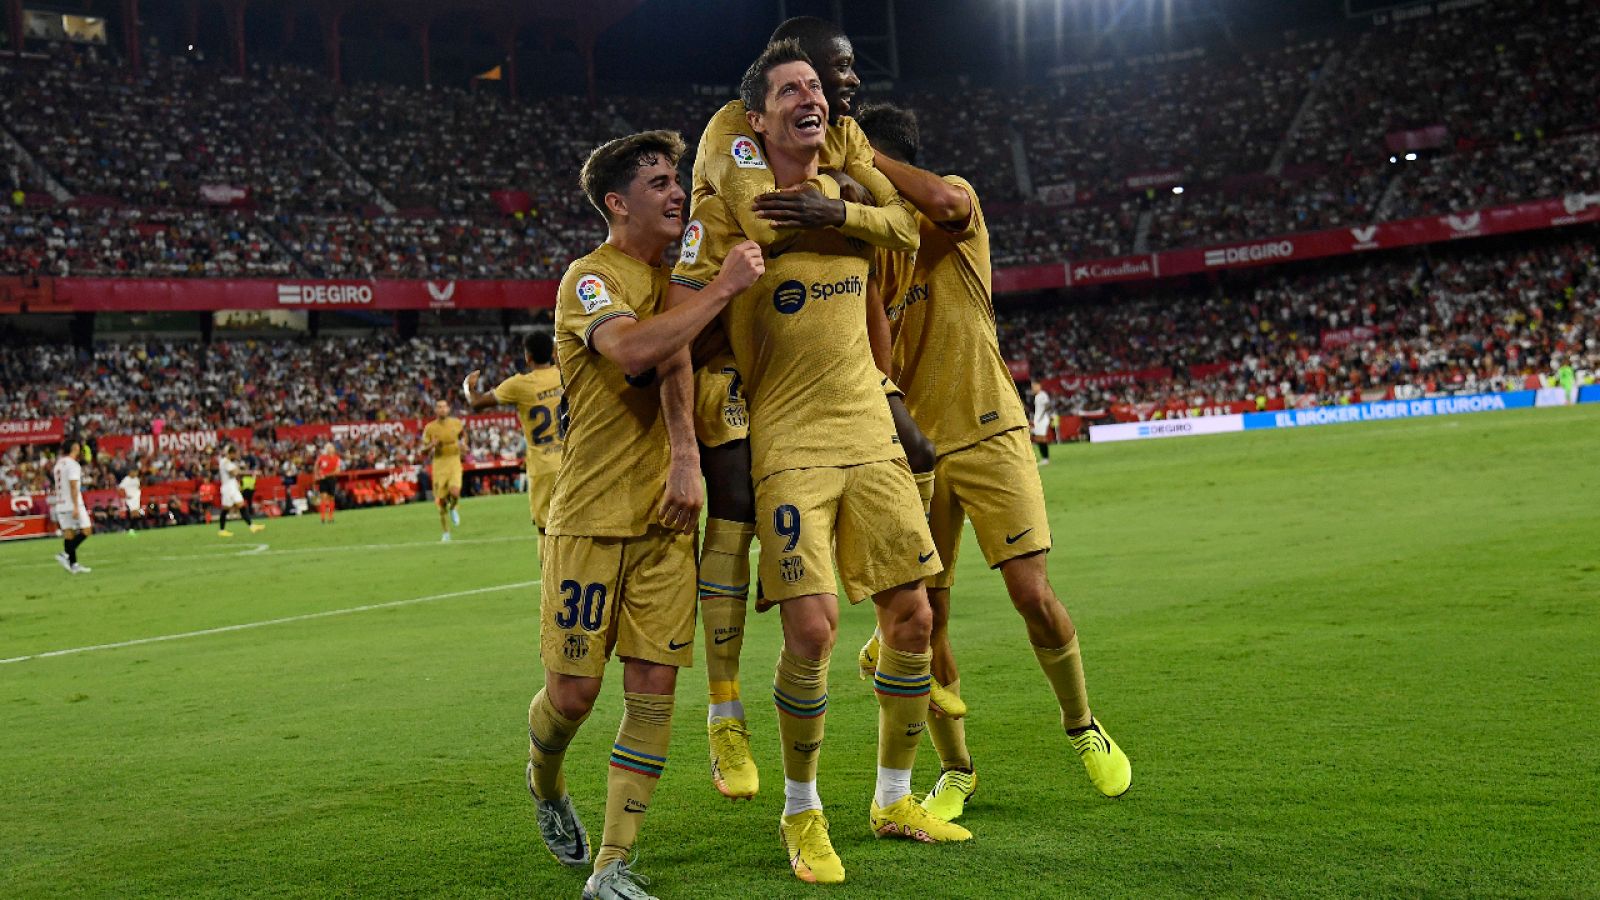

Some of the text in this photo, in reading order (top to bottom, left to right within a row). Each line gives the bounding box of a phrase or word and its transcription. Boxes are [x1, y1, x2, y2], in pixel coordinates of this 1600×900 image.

[1226, 241, 1294, 264] DEGIRO
[303, 285, 373, 304] DEGIRO
[810, 275, 864, 301] Spotify
[721, 366, 743, 402] 7
[1275, 413, 1297, 427] EL
[1362, 402, 1410, 419] LÍDER
[1411, 399, 1434, 416] DE
[1436, 394, 1506, 415] EUROPA
[0, 421, 30, 434] OBILE
[1150, 422, 1193, 436] DEGIRO
[133, 434, 154, 456] MI
[773, 504, 801, 553] 9
[554, 579, 608, 632] 30
